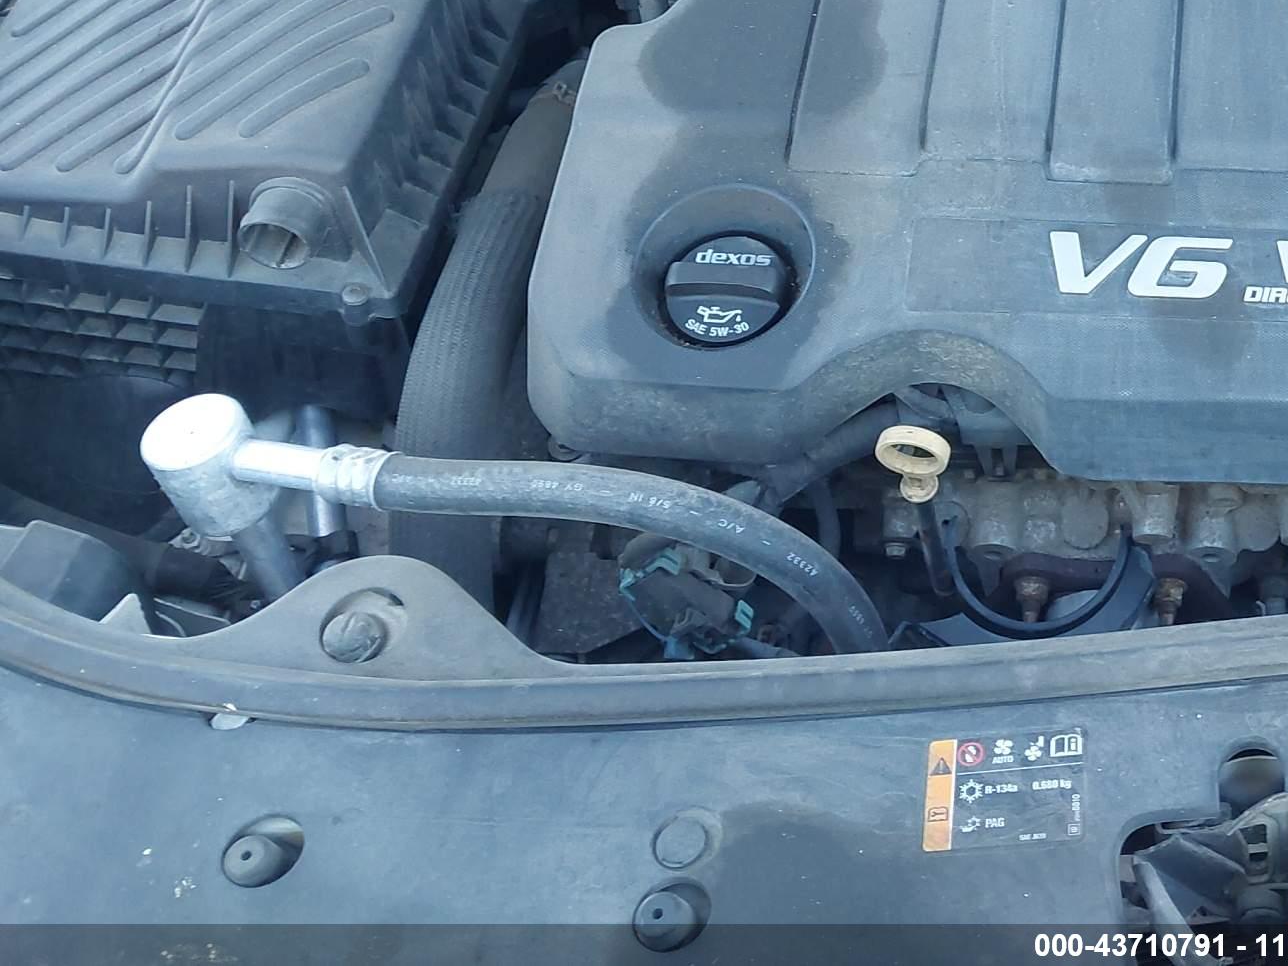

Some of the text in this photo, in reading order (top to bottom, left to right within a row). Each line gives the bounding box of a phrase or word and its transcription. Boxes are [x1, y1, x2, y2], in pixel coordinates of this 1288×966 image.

[695, 249, 775, 265] dexos
[1049, 230, 1234, 299] V6
[685, 319, 750, 337] SAE 5W-30
[628, 491, 644, 503] IN
[985, 783, 1018, 794] R-134a
[1060, 779, 1072, 790] kg
[985, 817, 1005, 828] PAG
